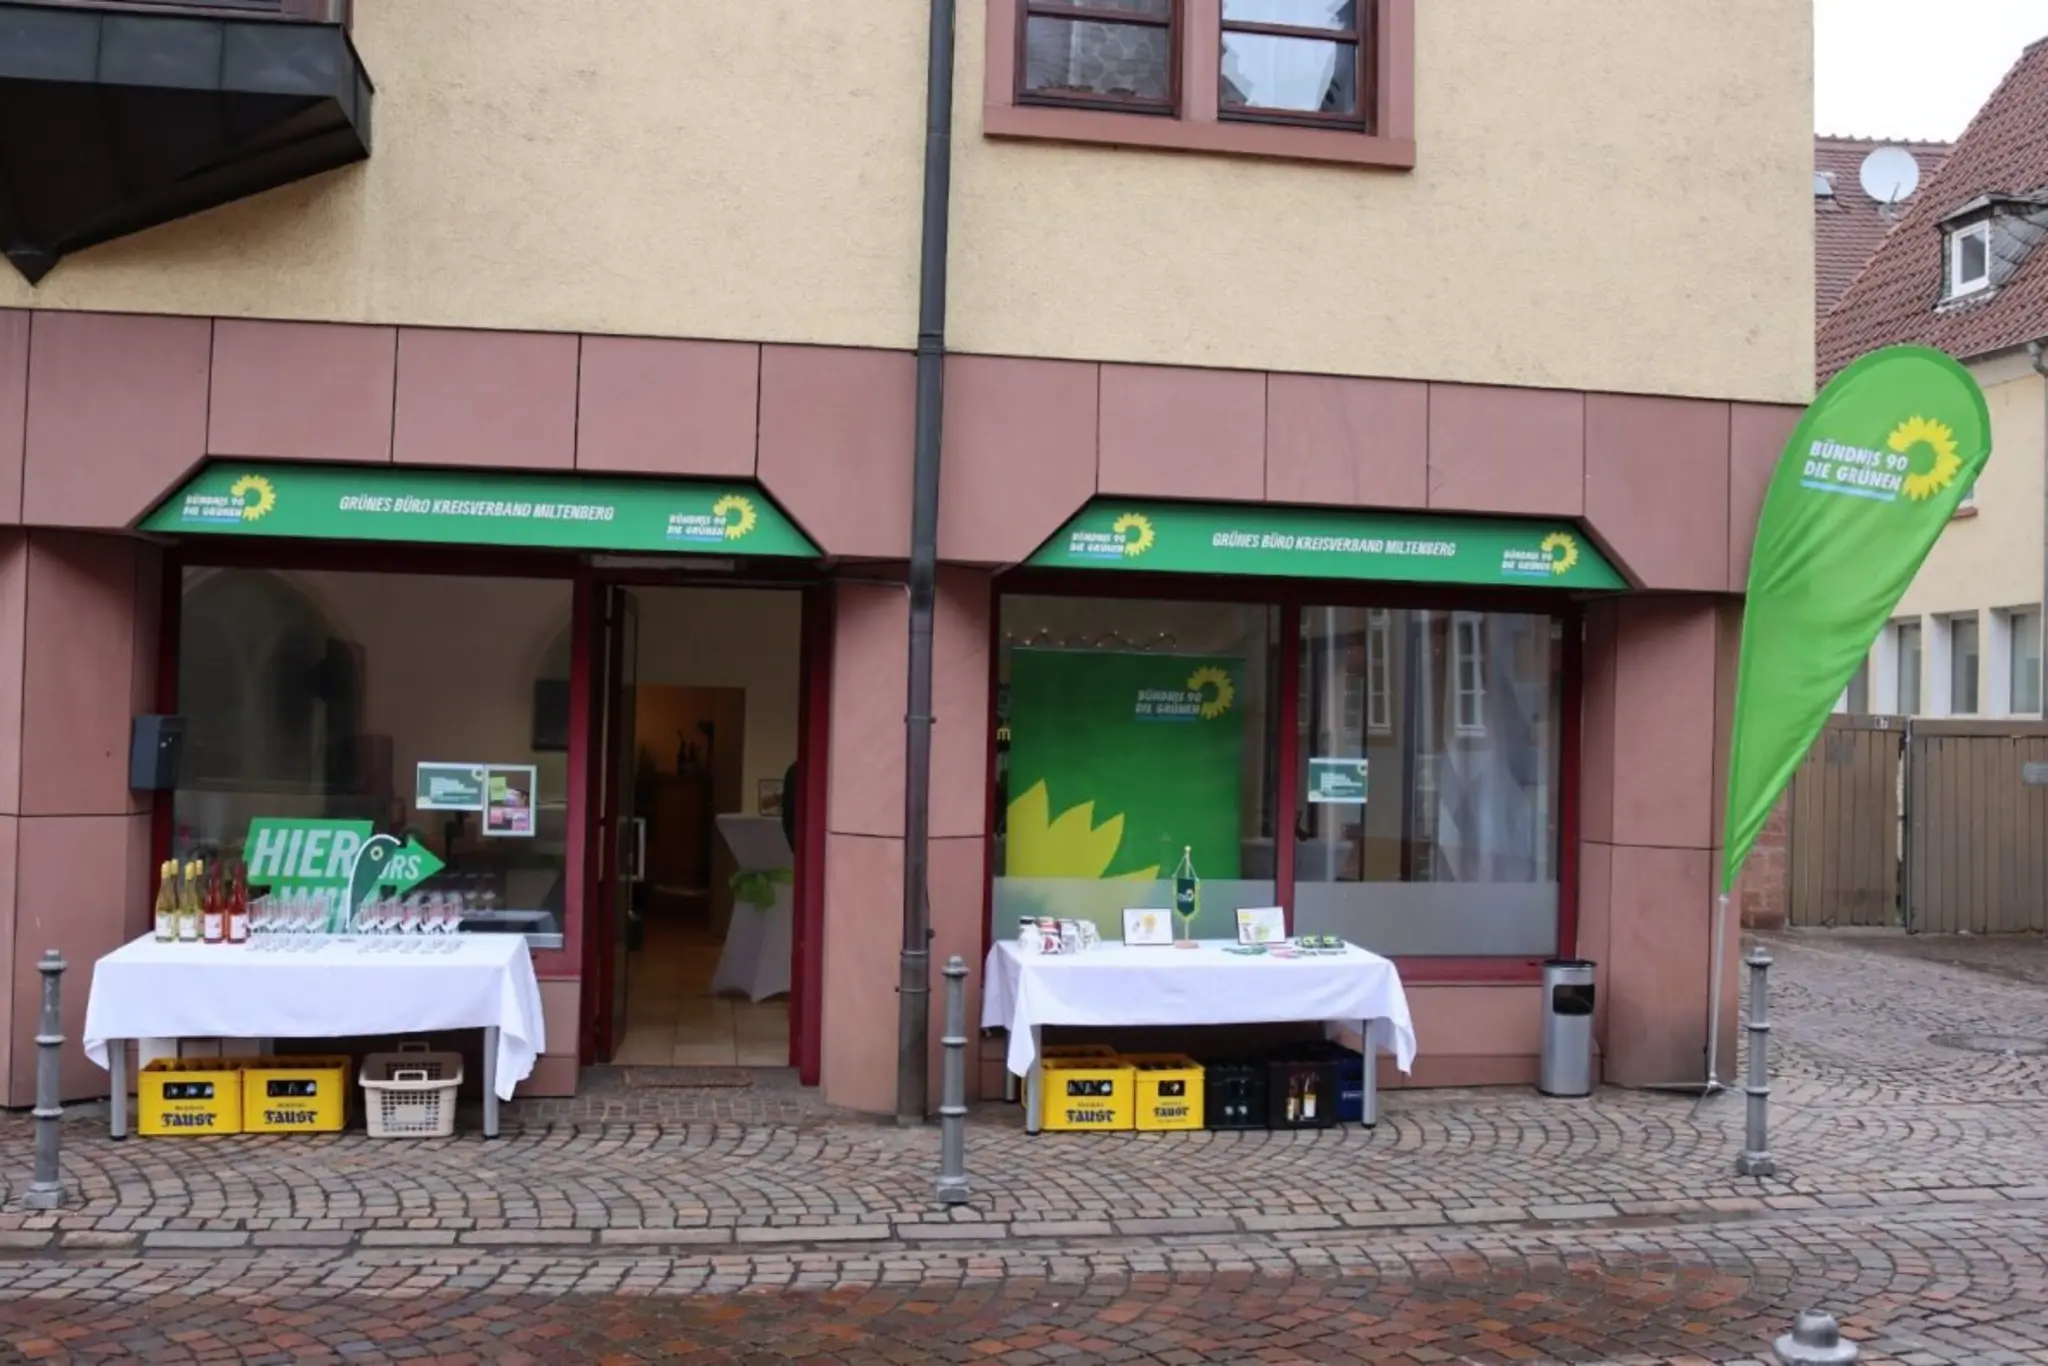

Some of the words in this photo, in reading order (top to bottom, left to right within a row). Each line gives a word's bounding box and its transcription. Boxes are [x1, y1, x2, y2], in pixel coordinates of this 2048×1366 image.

[1809, 439, 1882, 467] BÜNDNIS
[1886, 453, 1908, 471] 90
[1804, 460, 1832, 478] DIE
[1836, 463, 1902, 490] GRÜNEN
[340, 492, 392, 512] GRÜNES
[393, 495, 431, 514] BÜRO
[432, 499, 532, 517] KREISVERBAND
[533, 503, 615, 520] MILTENBERG
[1212, 530, 1260, 549] GRÜNES
[1261, 531, 1295, 550] BÜRO
[1295, 535, 1384, 553] KREISVERBAND
[1385, 539, 1457, 556] MILTENBERG
[250, 829, 360, 877] HIER
[161, 1112, 217, 1127] FAUST
[264, 1110, 319, 1125] FAUST
[1066, 1109, 1116, 1123] FAUST
[1153, 1106, 1190, 1118] FAUST
